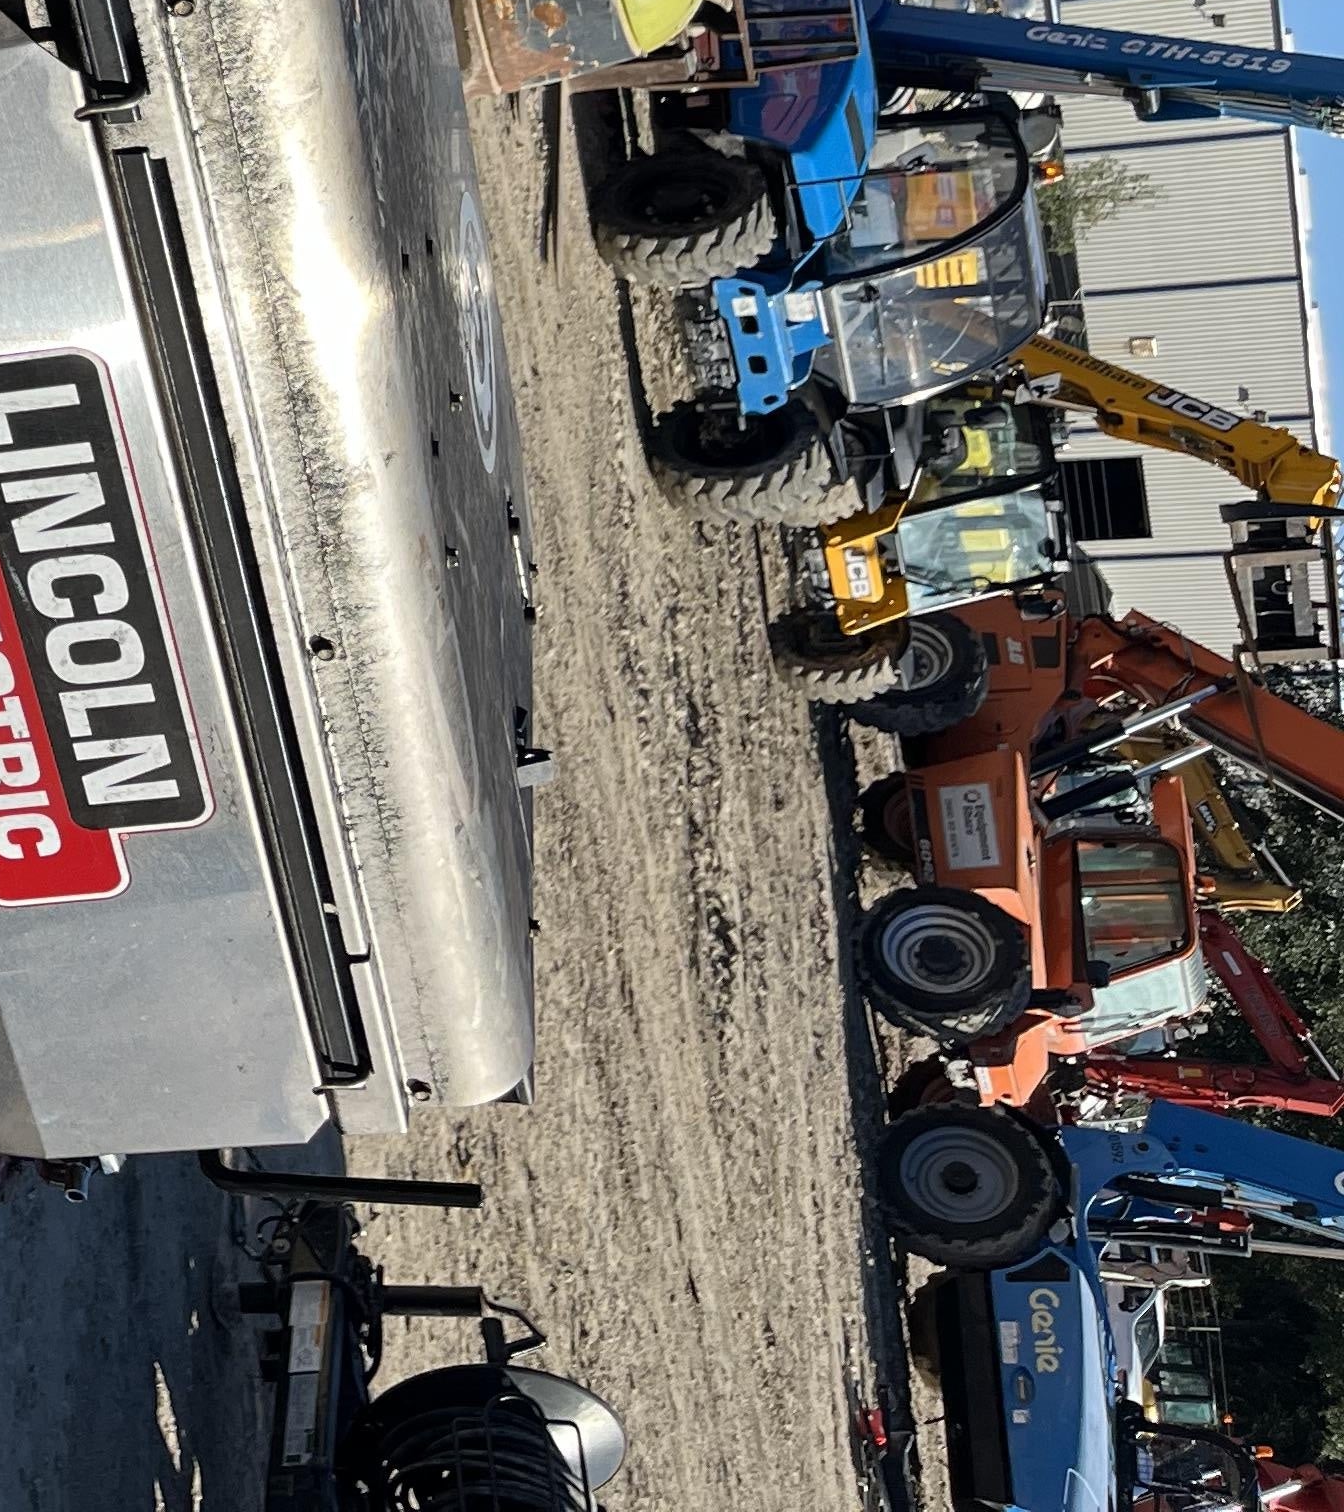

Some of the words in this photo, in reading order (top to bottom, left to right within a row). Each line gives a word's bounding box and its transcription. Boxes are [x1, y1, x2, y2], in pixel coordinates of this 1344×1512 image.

[1025, 25, 1109, 50] Genie
[1119, 38, 1292, 75] GTH-5519
[1145, 387, 1241, 432] JCB
[1029, 1287, 1064, 1374] Genie
